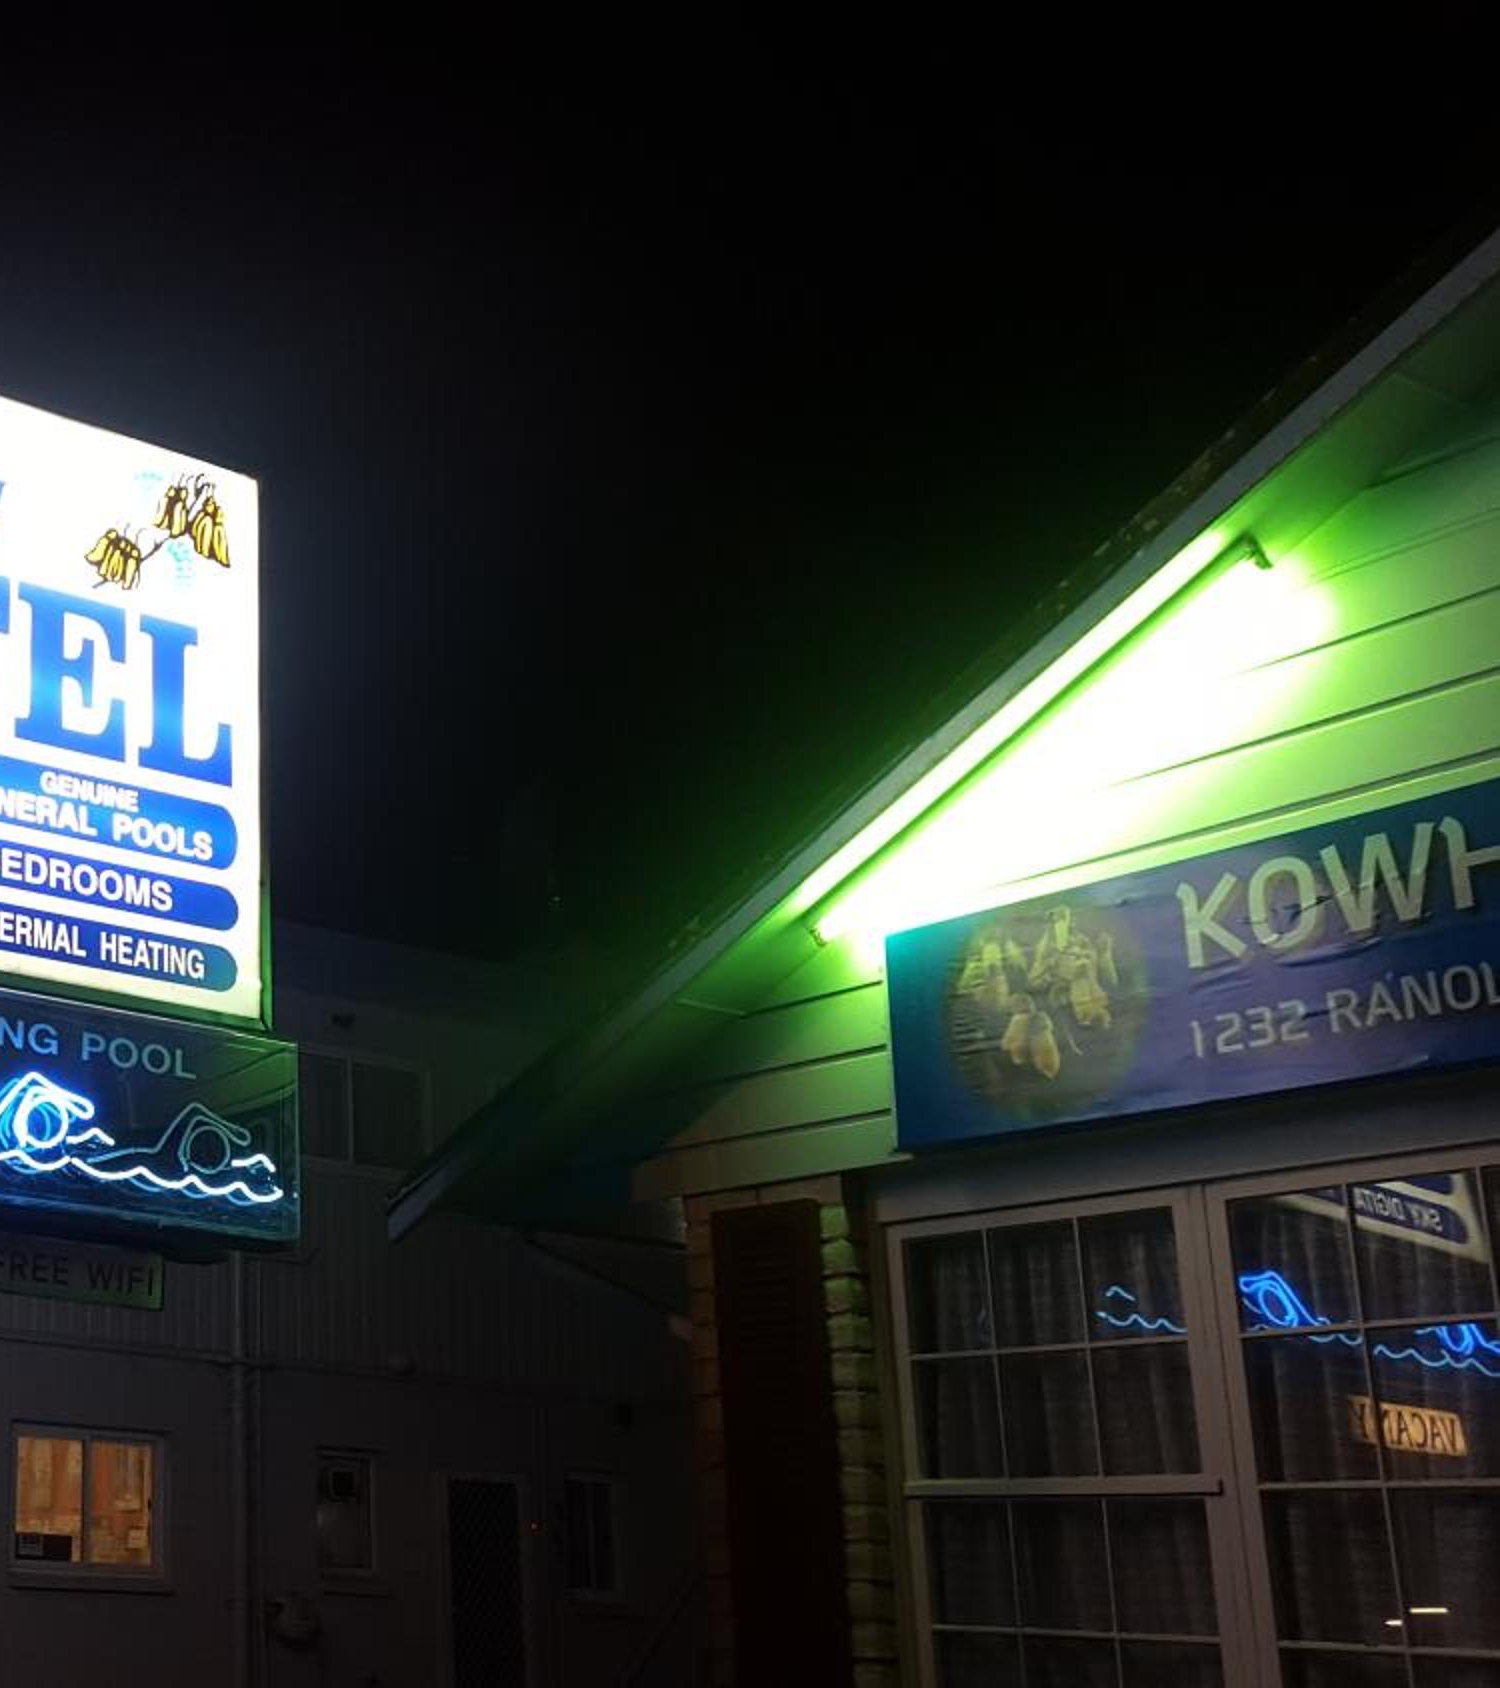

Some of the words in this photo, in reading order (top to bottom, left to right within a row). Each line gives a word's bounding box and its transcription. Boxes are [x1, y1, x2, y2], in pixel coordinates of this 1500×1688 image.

[39, 770, 140, 813] GENUINE
[111, 812, 214, 862] POOLS
[100, 931, 205, 980] HEATING
[1190, 999, 1308, 1059] 1232
[82, 1035, 197, 1080] POOL
[86, 1258, 155, 1297] WIFI
